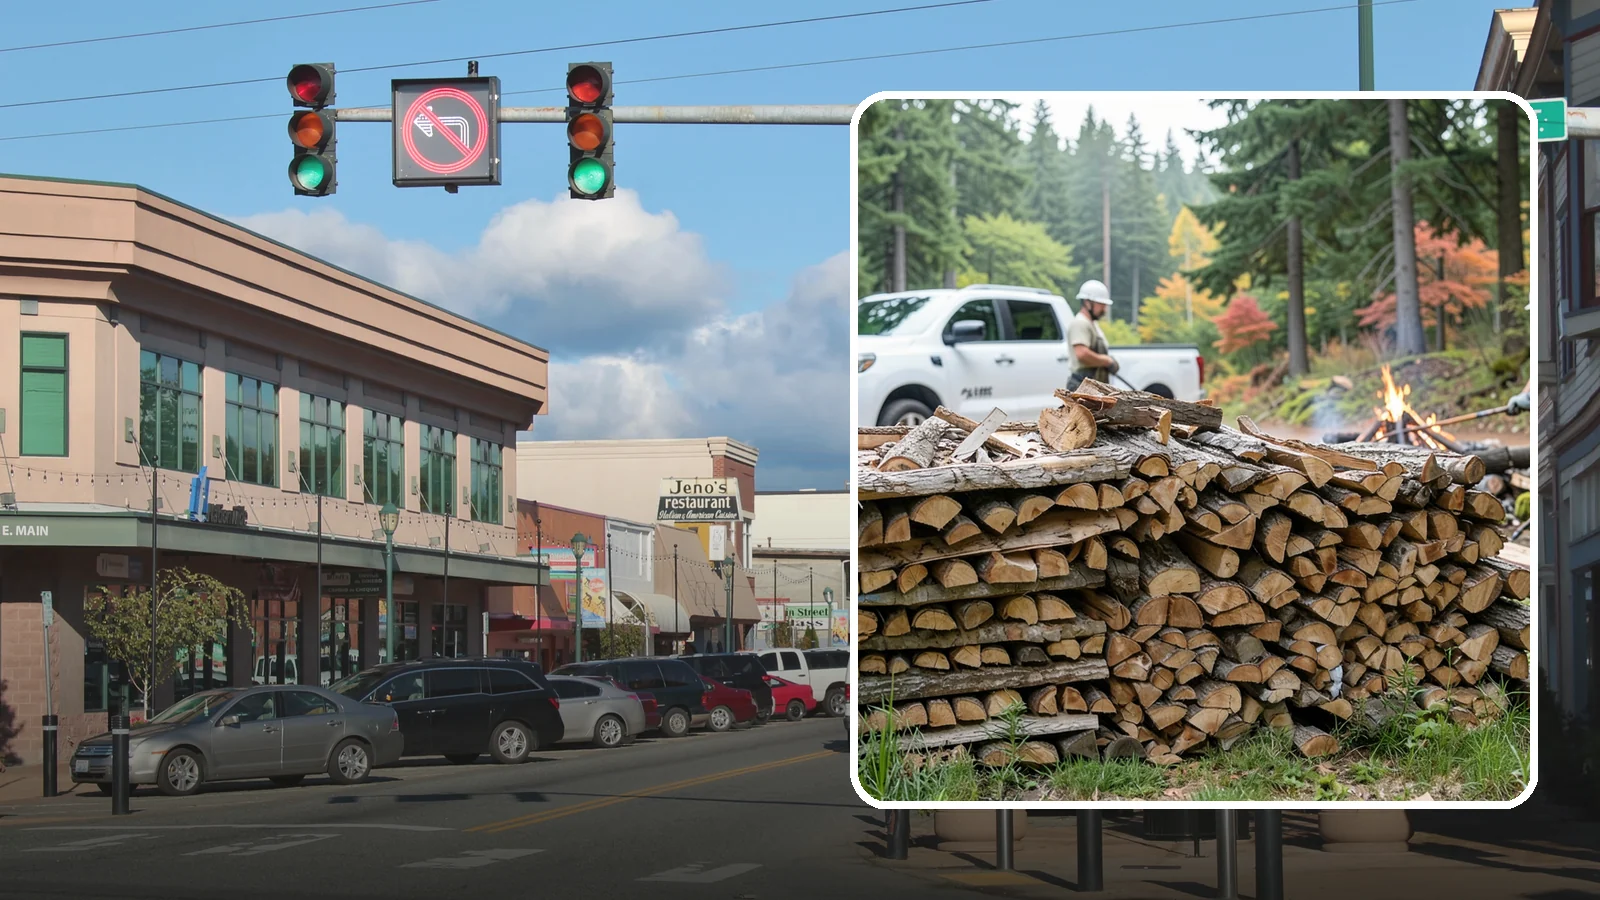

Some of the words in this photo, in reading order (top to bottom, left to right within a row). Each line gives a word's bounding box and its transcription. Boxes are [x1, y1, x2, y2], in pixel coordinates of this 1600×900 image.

[670, 480, 728, 495] Jeno's
[665, 496, 731, 509] restaurant
[659, 510, 682, 520] Italian
[686, 509, 715, 519] American
[715, 509, 737, 519] Cuisine
[2, 525, 13, 536] E.
[15, 525, 49, 536] MAIN
[797, 607, 829, 617] Street
[790, 619, 824, 627] lass
